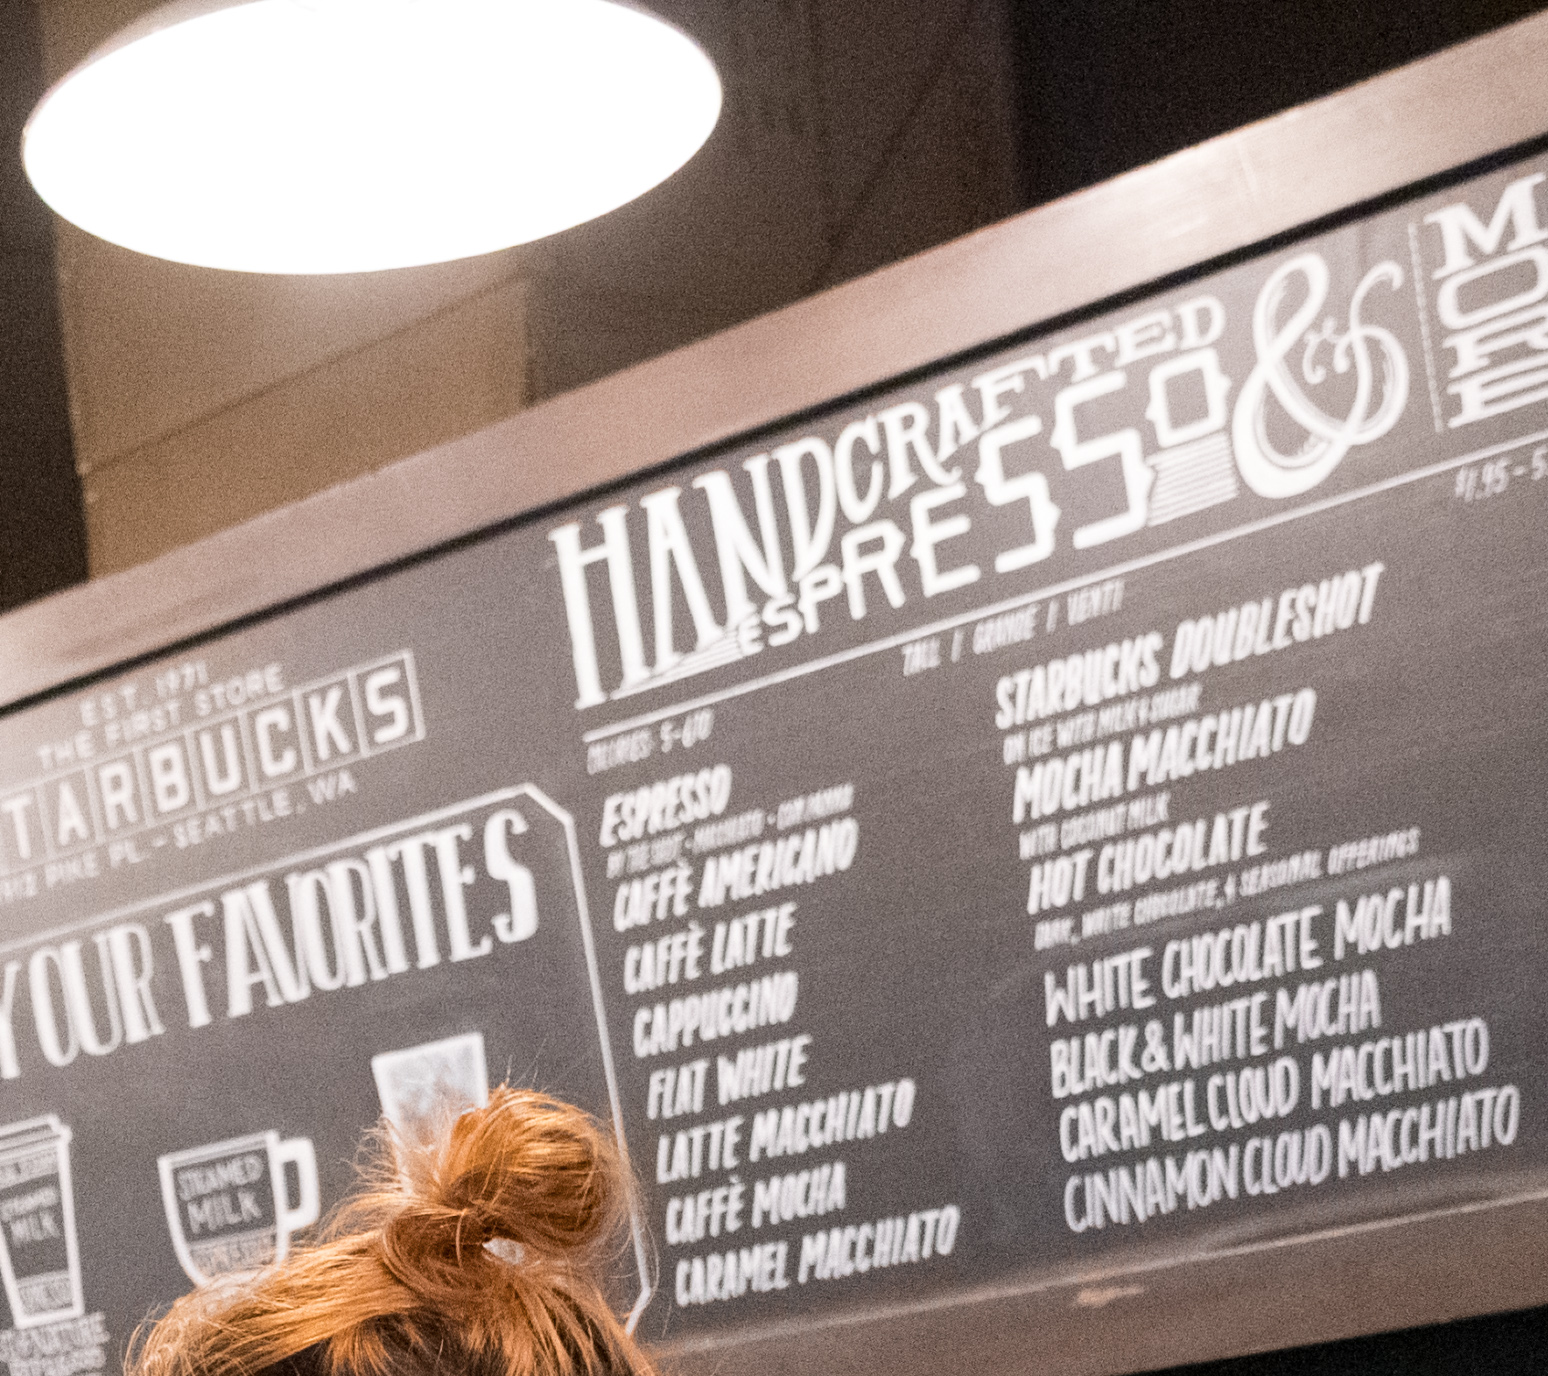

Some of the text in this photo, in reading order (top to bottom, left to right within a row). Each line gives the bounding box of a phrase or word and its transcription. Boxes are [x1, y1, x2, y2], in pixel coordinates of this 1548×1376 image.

[548, 253, 1410, 710] HANDCRAFTED &
[737, 346, 1232, 657] ESPRESSO
[995, 561, 1385, 730] STARBUCKS DOUBLESHOT
[39, 664, 283, 769] THE FIRST STORE
[1013, 688, 1317, 825] MOCHA MACCHIATO
[45, 771, 357, 893] PIKE WA
[600, 763, 732, 848] ESPRESSO
[1027, 802, 1271, 915] HOT CHOCOLATE
[698, 817, 859, 908] AMERICANO
[28, 922, 166, 1067] OUR
[166, 808, 539, 1029] FAVORITES
[710, 902, 799, 976] LATTE
[1044, 875, 1452, 1028] WHITE CHOCOLATE MOCHA
[634, 971, 799, 1058] CAPPUCCINO
[1051, 969, 1382, 1099] BLACK WHITE MOCHA
[647, 1036, 812, 1119] FLAT WHITE
[657, 1079, 916, 1184] LATTE MACCHIATO
[1059, 1017, 1490, 1163] CARAMEL CLOUD MACCHIATO
[178, 1155, 264, 1200] STEAMED
[187, 1189, 262, 1234] MILK
[752, 1161, 848, 1229] MOCHA
[1064, 1085, 1521, 1232] CINNAMON CLOUD MACCHIATO
[676, 1206, 960, 1307] CARAMEL MACCHIATO
